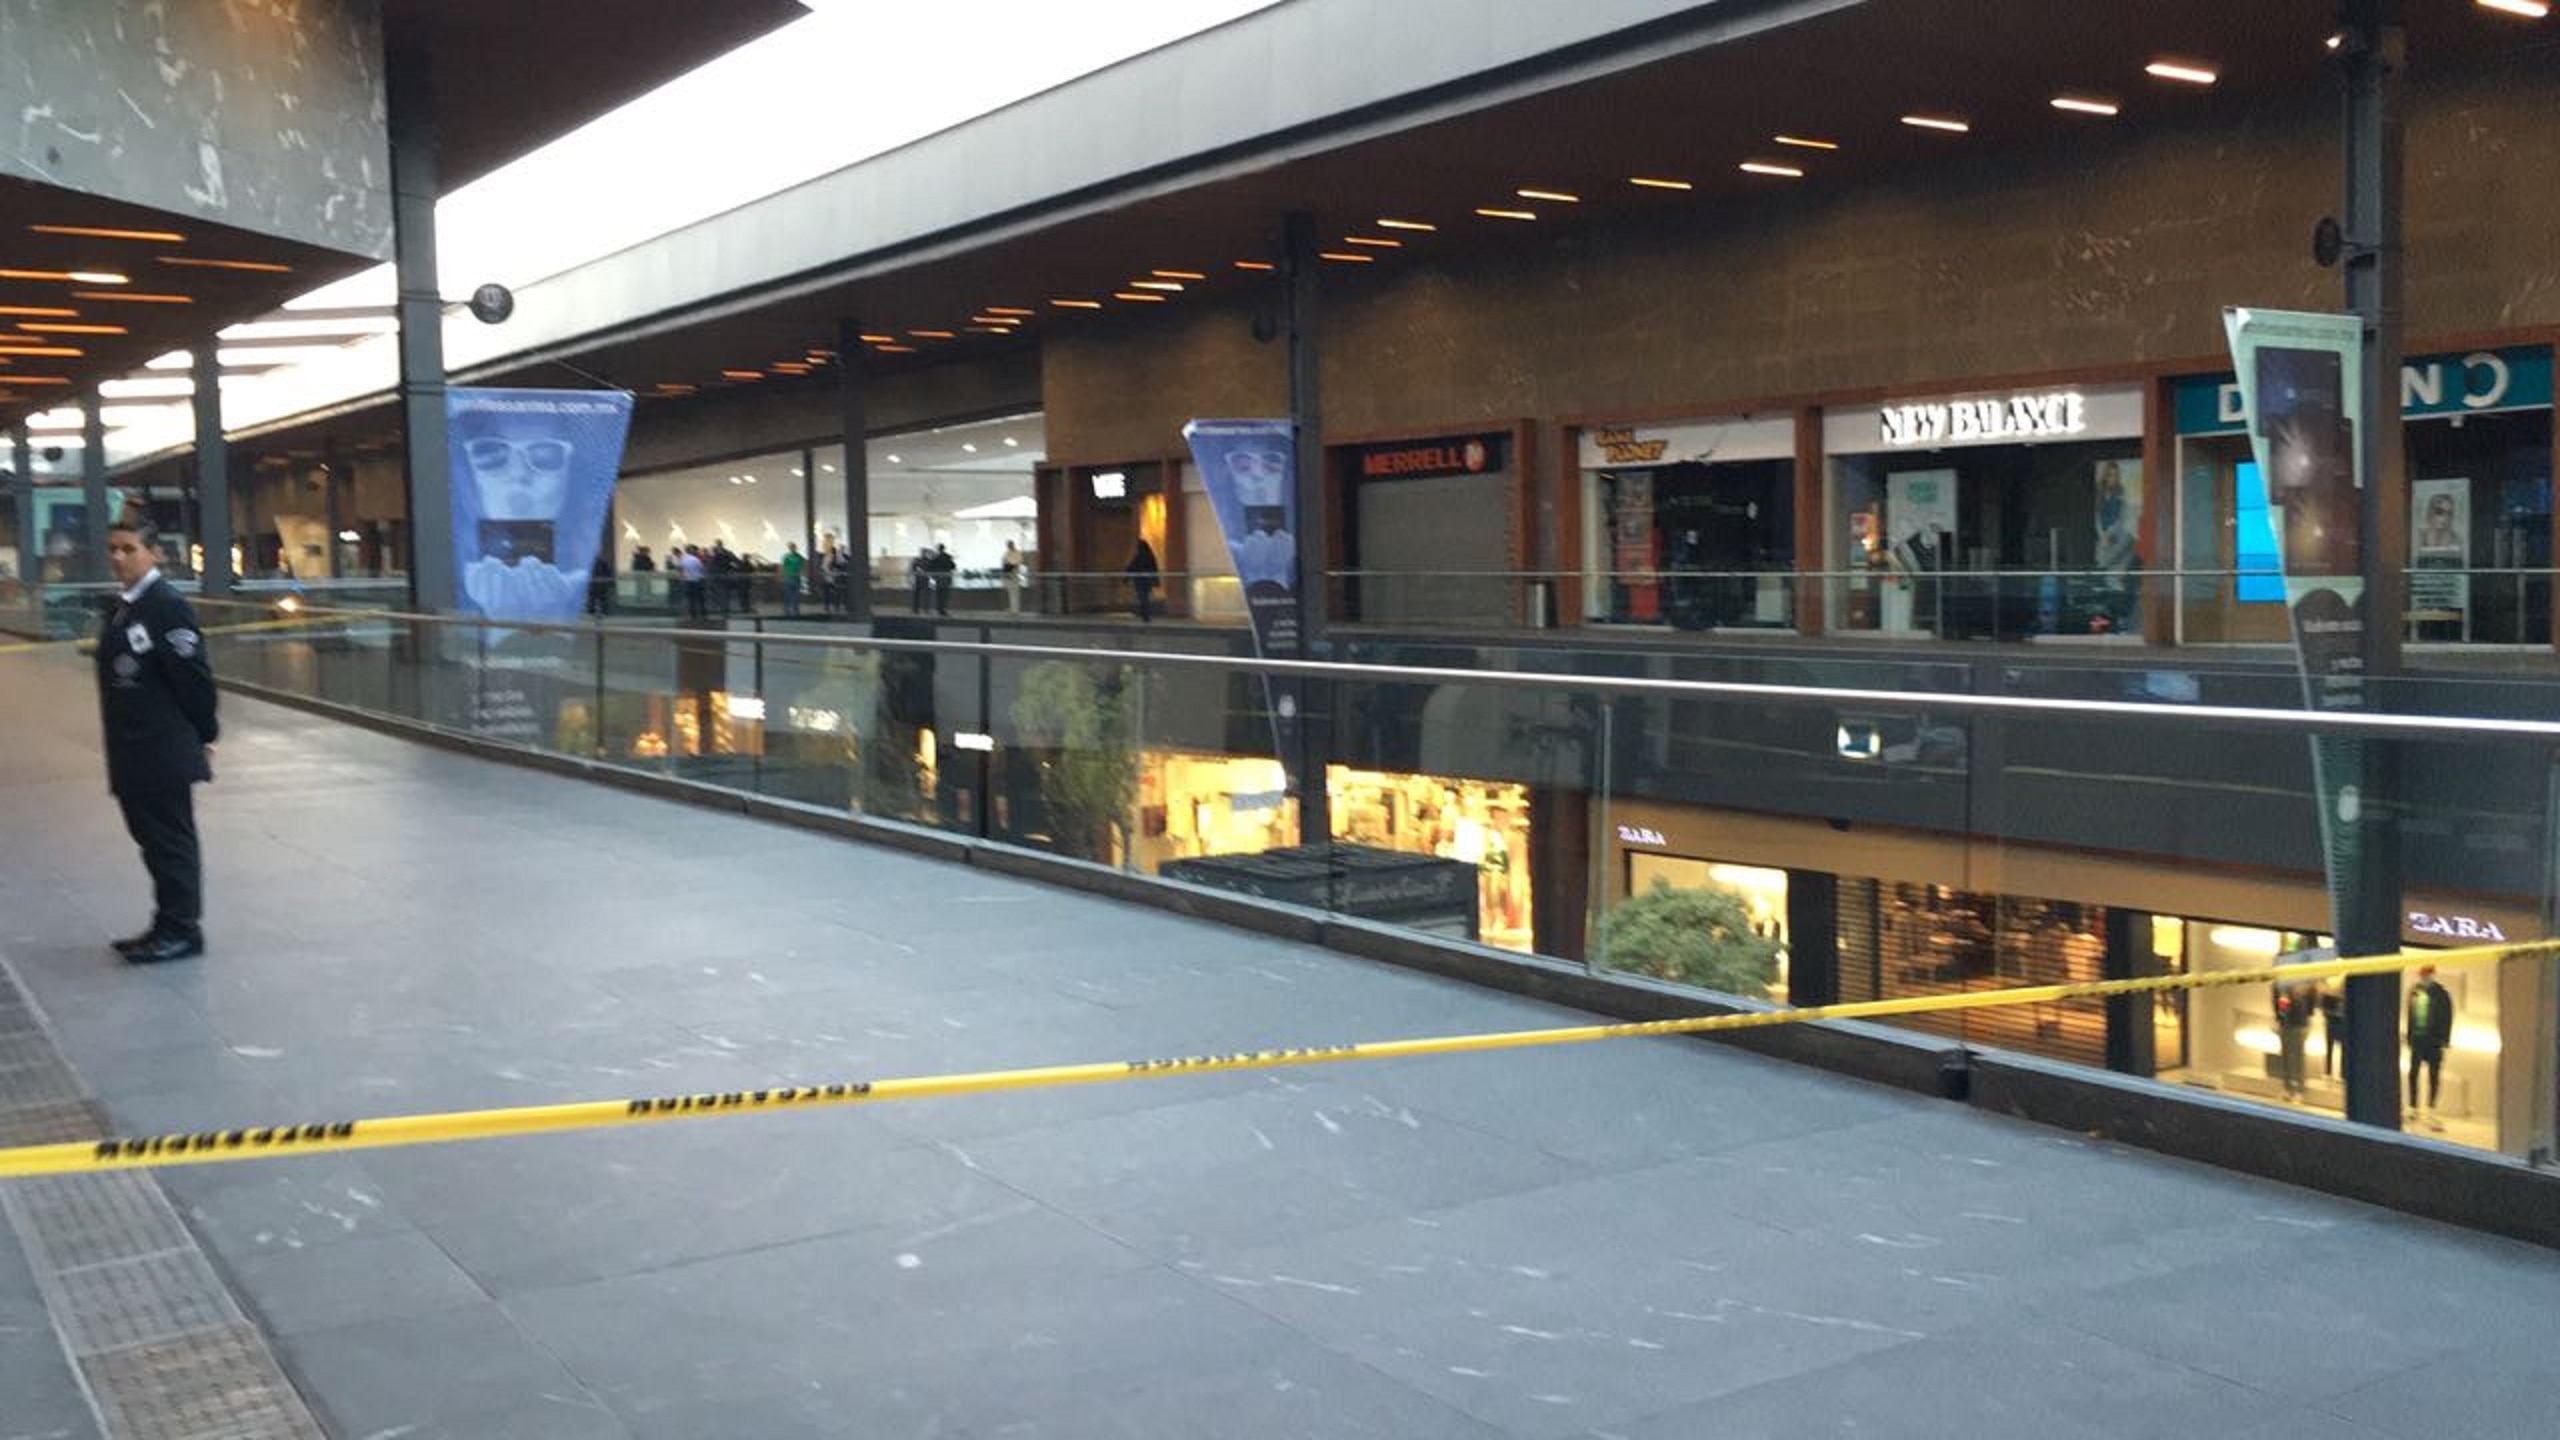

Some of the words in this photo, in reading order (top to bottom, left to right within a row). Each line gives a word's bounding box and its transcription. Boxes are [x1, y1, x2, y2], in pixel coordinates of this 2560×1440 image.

[1880, 405, 1947, 445] NEW
[1949, 393, 2086, 441] BALANCE
[1363, 446, 1462, 476] MERRELL
[2408, 911, 2506, 942] ZARA
